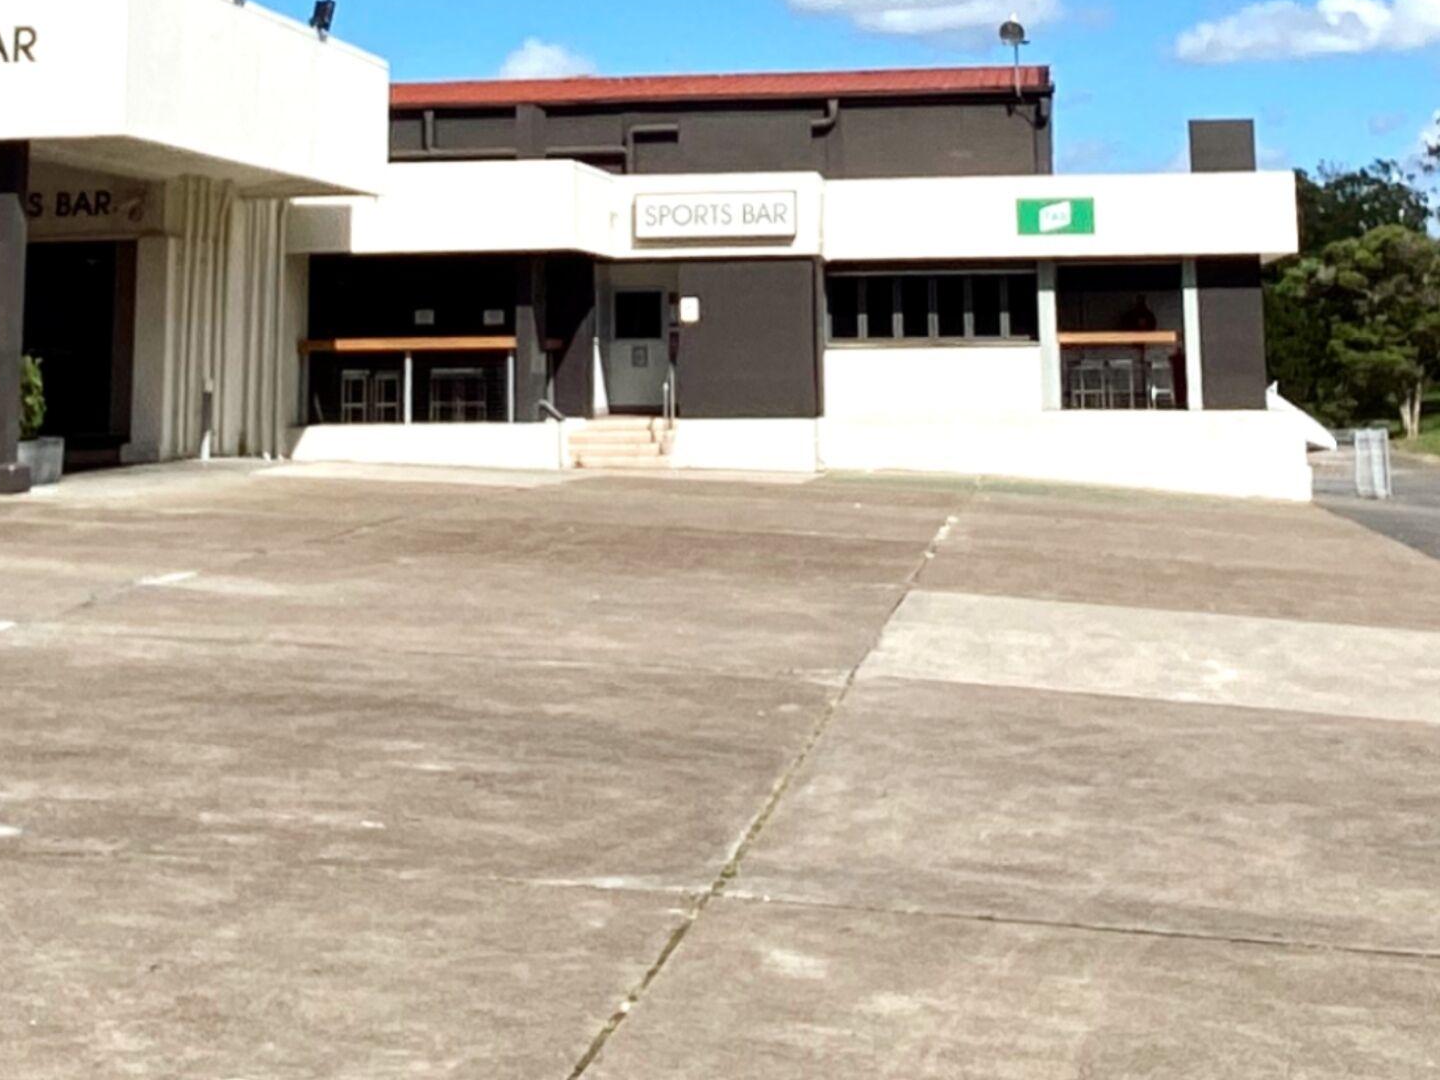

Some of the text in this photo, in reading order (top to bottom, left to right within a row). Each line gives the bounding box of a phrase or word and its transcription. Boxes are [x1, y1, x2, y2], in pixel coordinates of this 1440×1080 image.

[55, 189, 111, 217] BAR
[644, 202, 788, 228] SPORTS BAR
